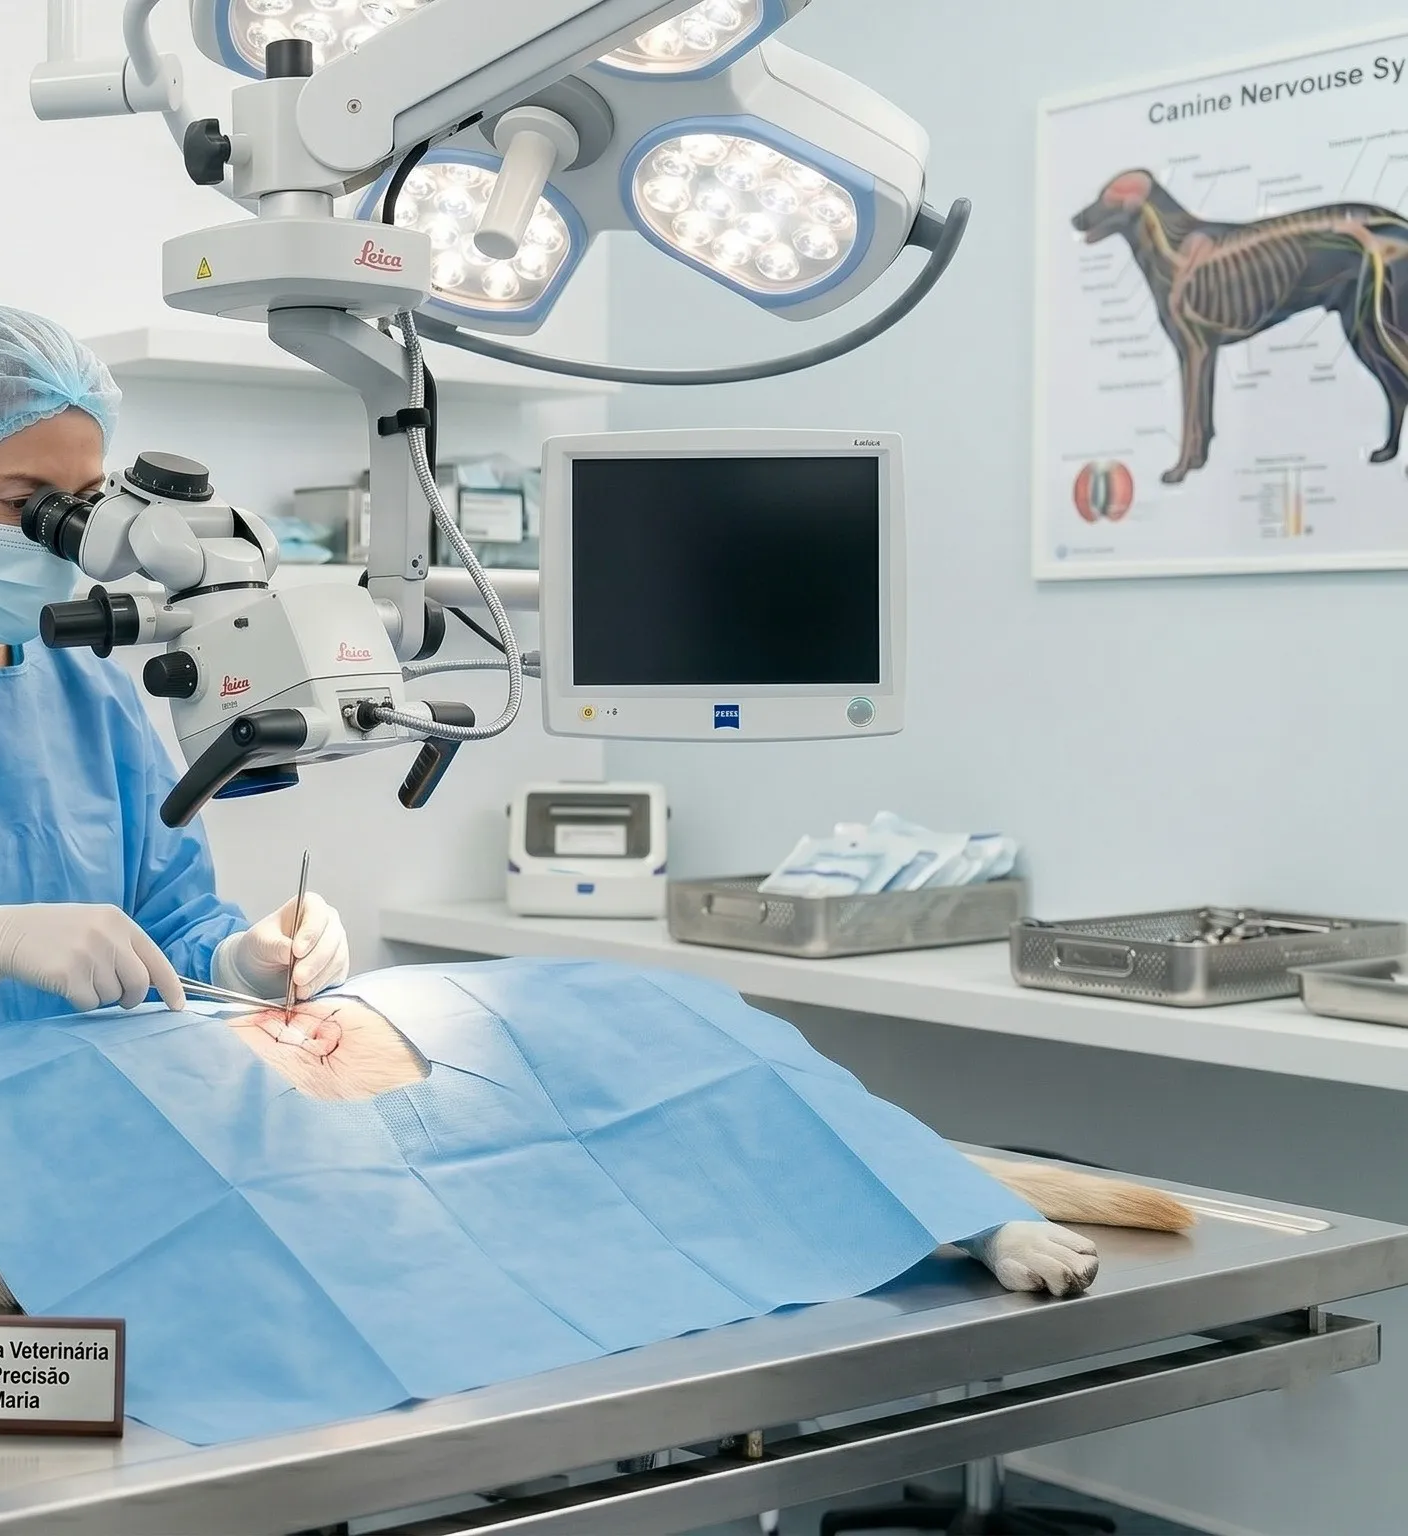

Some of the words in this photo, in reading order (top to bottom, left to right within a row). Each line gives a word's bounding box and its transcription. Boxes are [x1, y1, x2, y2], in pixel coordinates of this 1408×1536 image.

[1148, 93, 1232, 124] Canine
[1240, 66, 1363, 106] Nervouse
[1374, 57, 1406, 83] Sy
[353, 240, 403, 272] Leica
[10, 1341, 109, 1361] Veterinária
